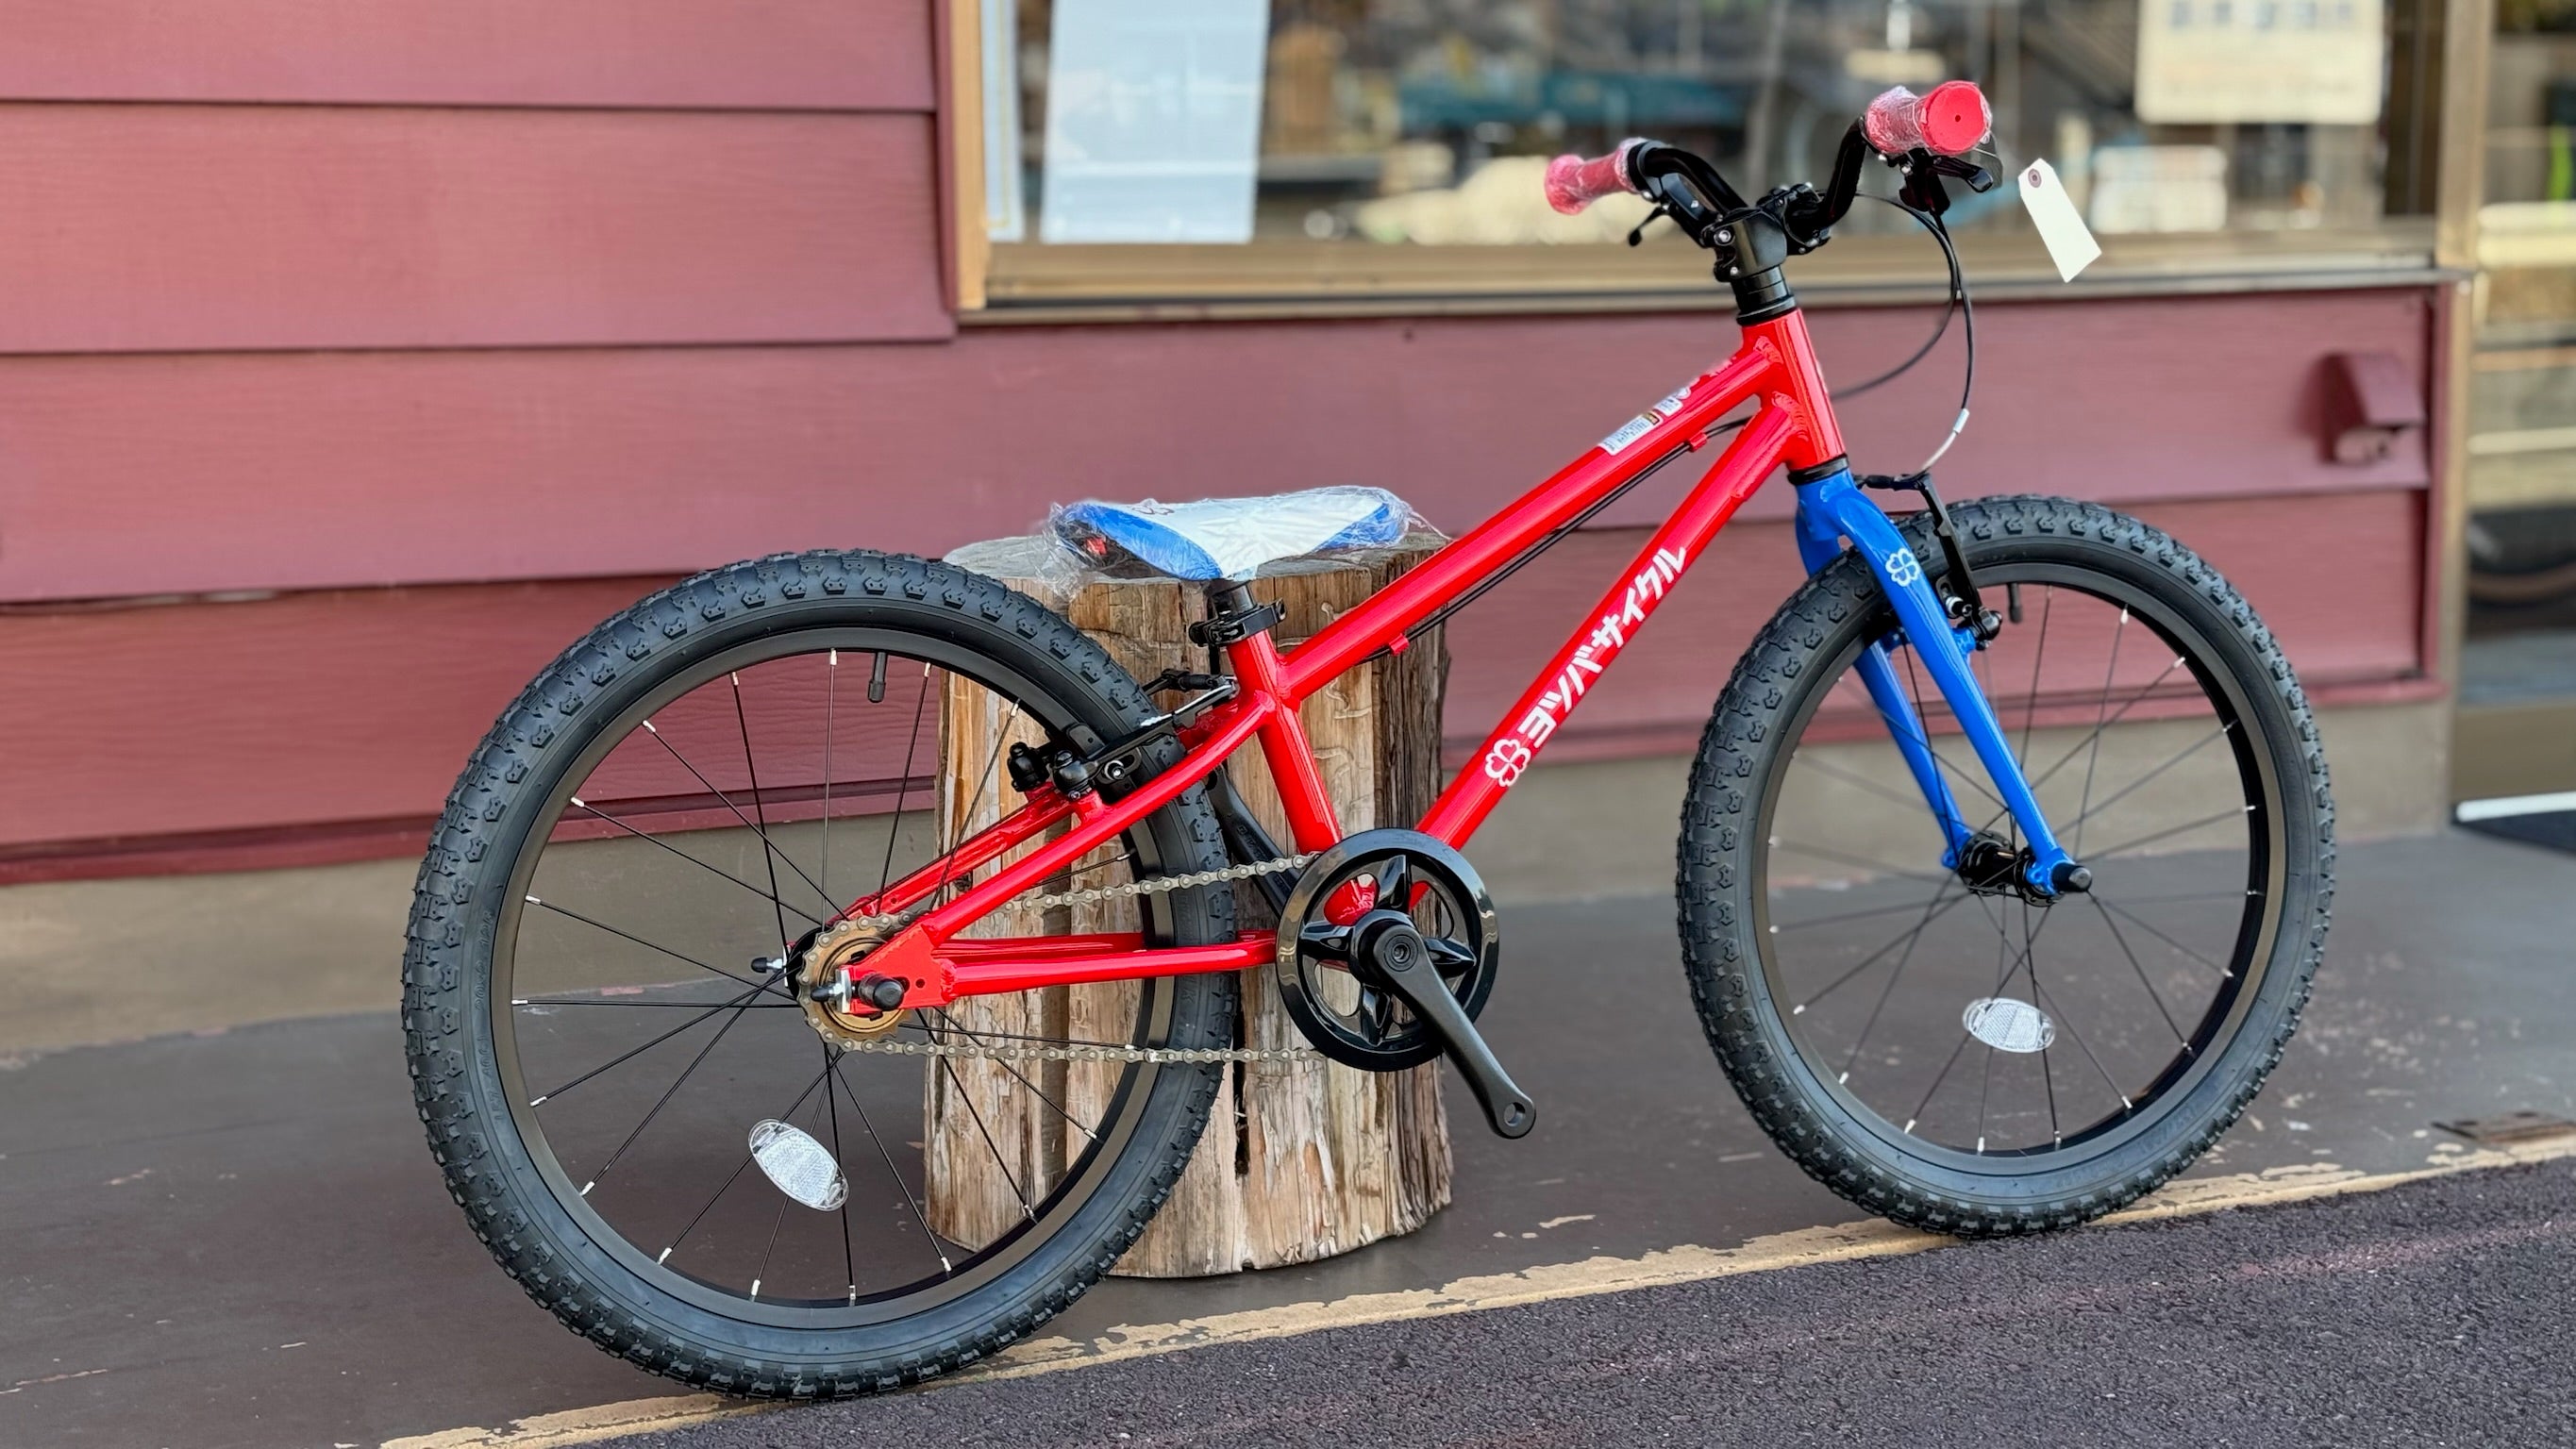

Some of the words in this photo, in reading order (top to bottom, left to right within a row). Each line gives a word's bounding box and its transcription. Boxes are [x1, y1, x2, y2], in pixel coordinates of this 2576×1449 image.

[1517, 546, 1686, 748] ヨツバサイクル
